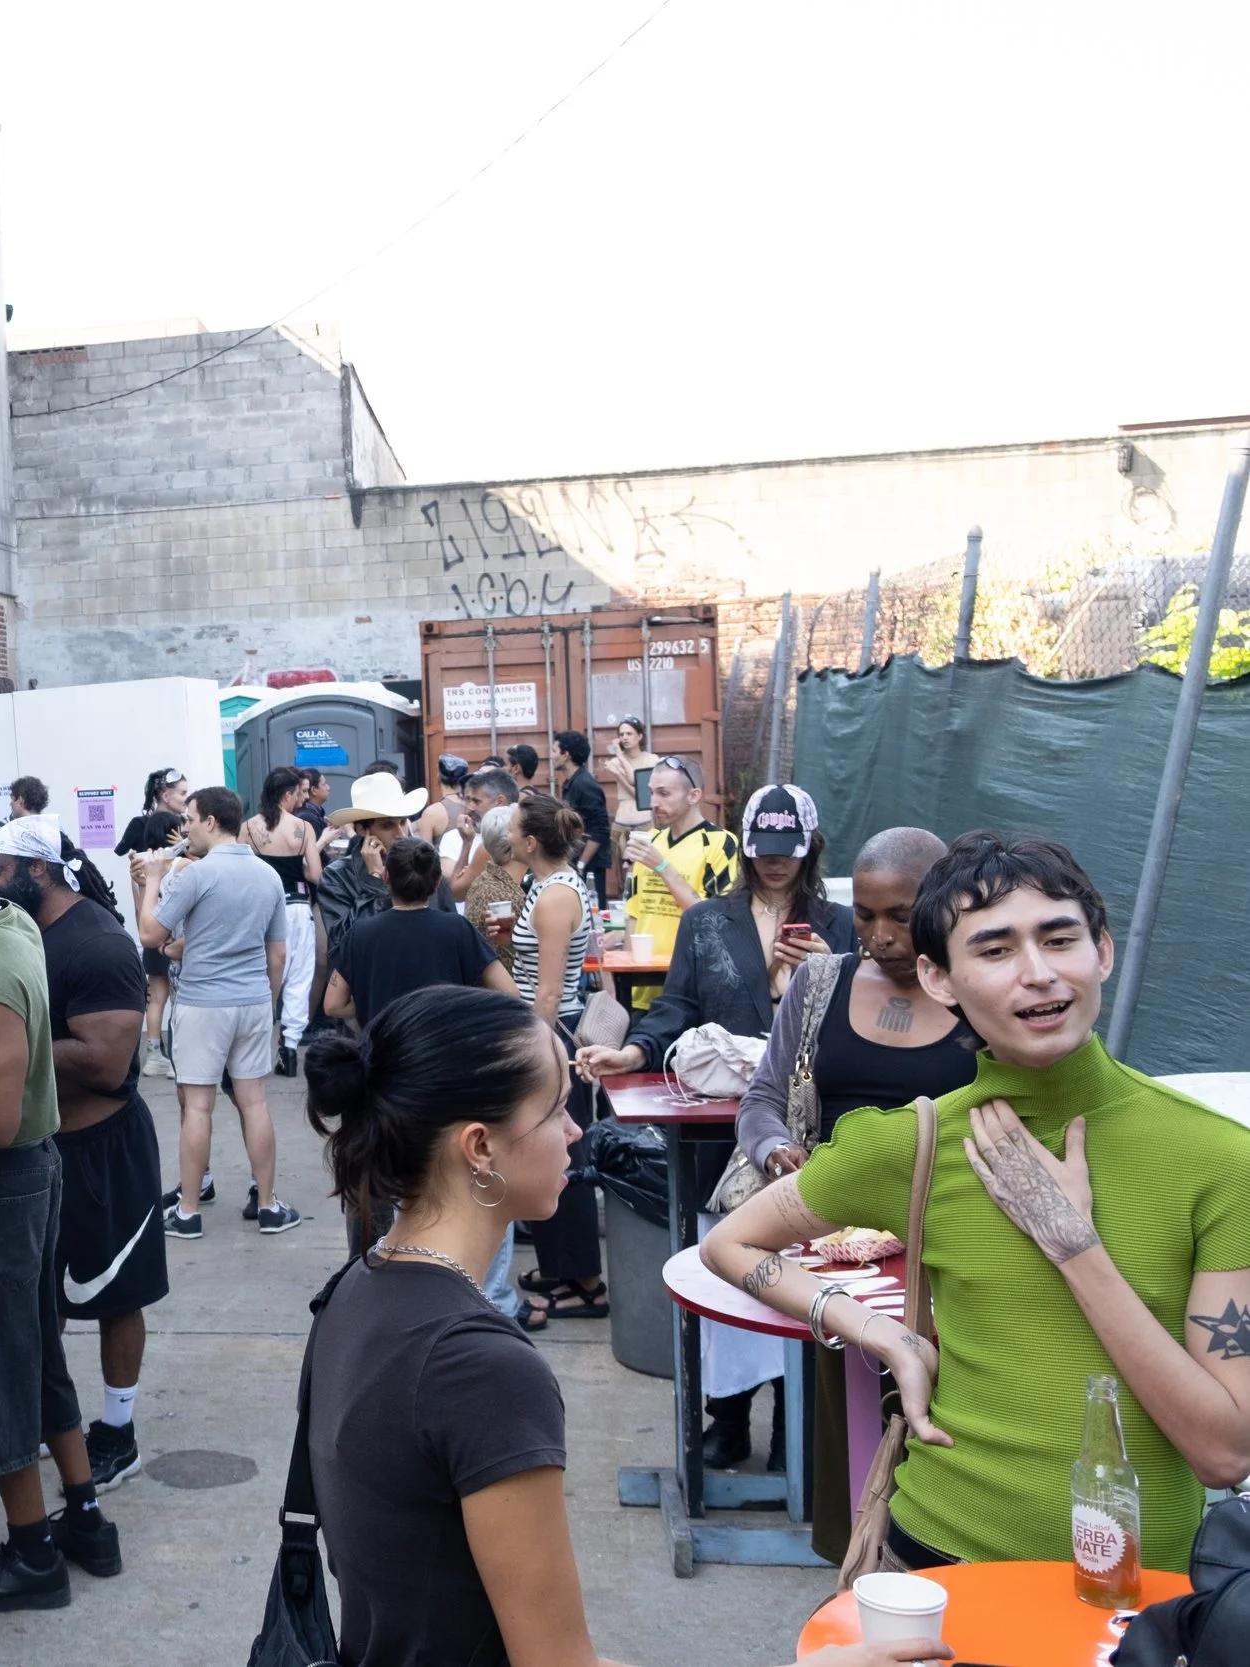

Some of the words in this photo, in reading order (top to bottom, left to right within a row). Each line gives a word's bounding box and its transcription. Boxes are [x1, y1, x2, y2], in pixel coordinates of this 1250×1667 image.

[649, 639, 696, 655] 299632
[649, 656, 674, 671] 2210
[447, 688, 465, 696] TRS
[468, 685, 532, 695] CONAINERS
[1075, 1525, 1118, 1546] ERBA
